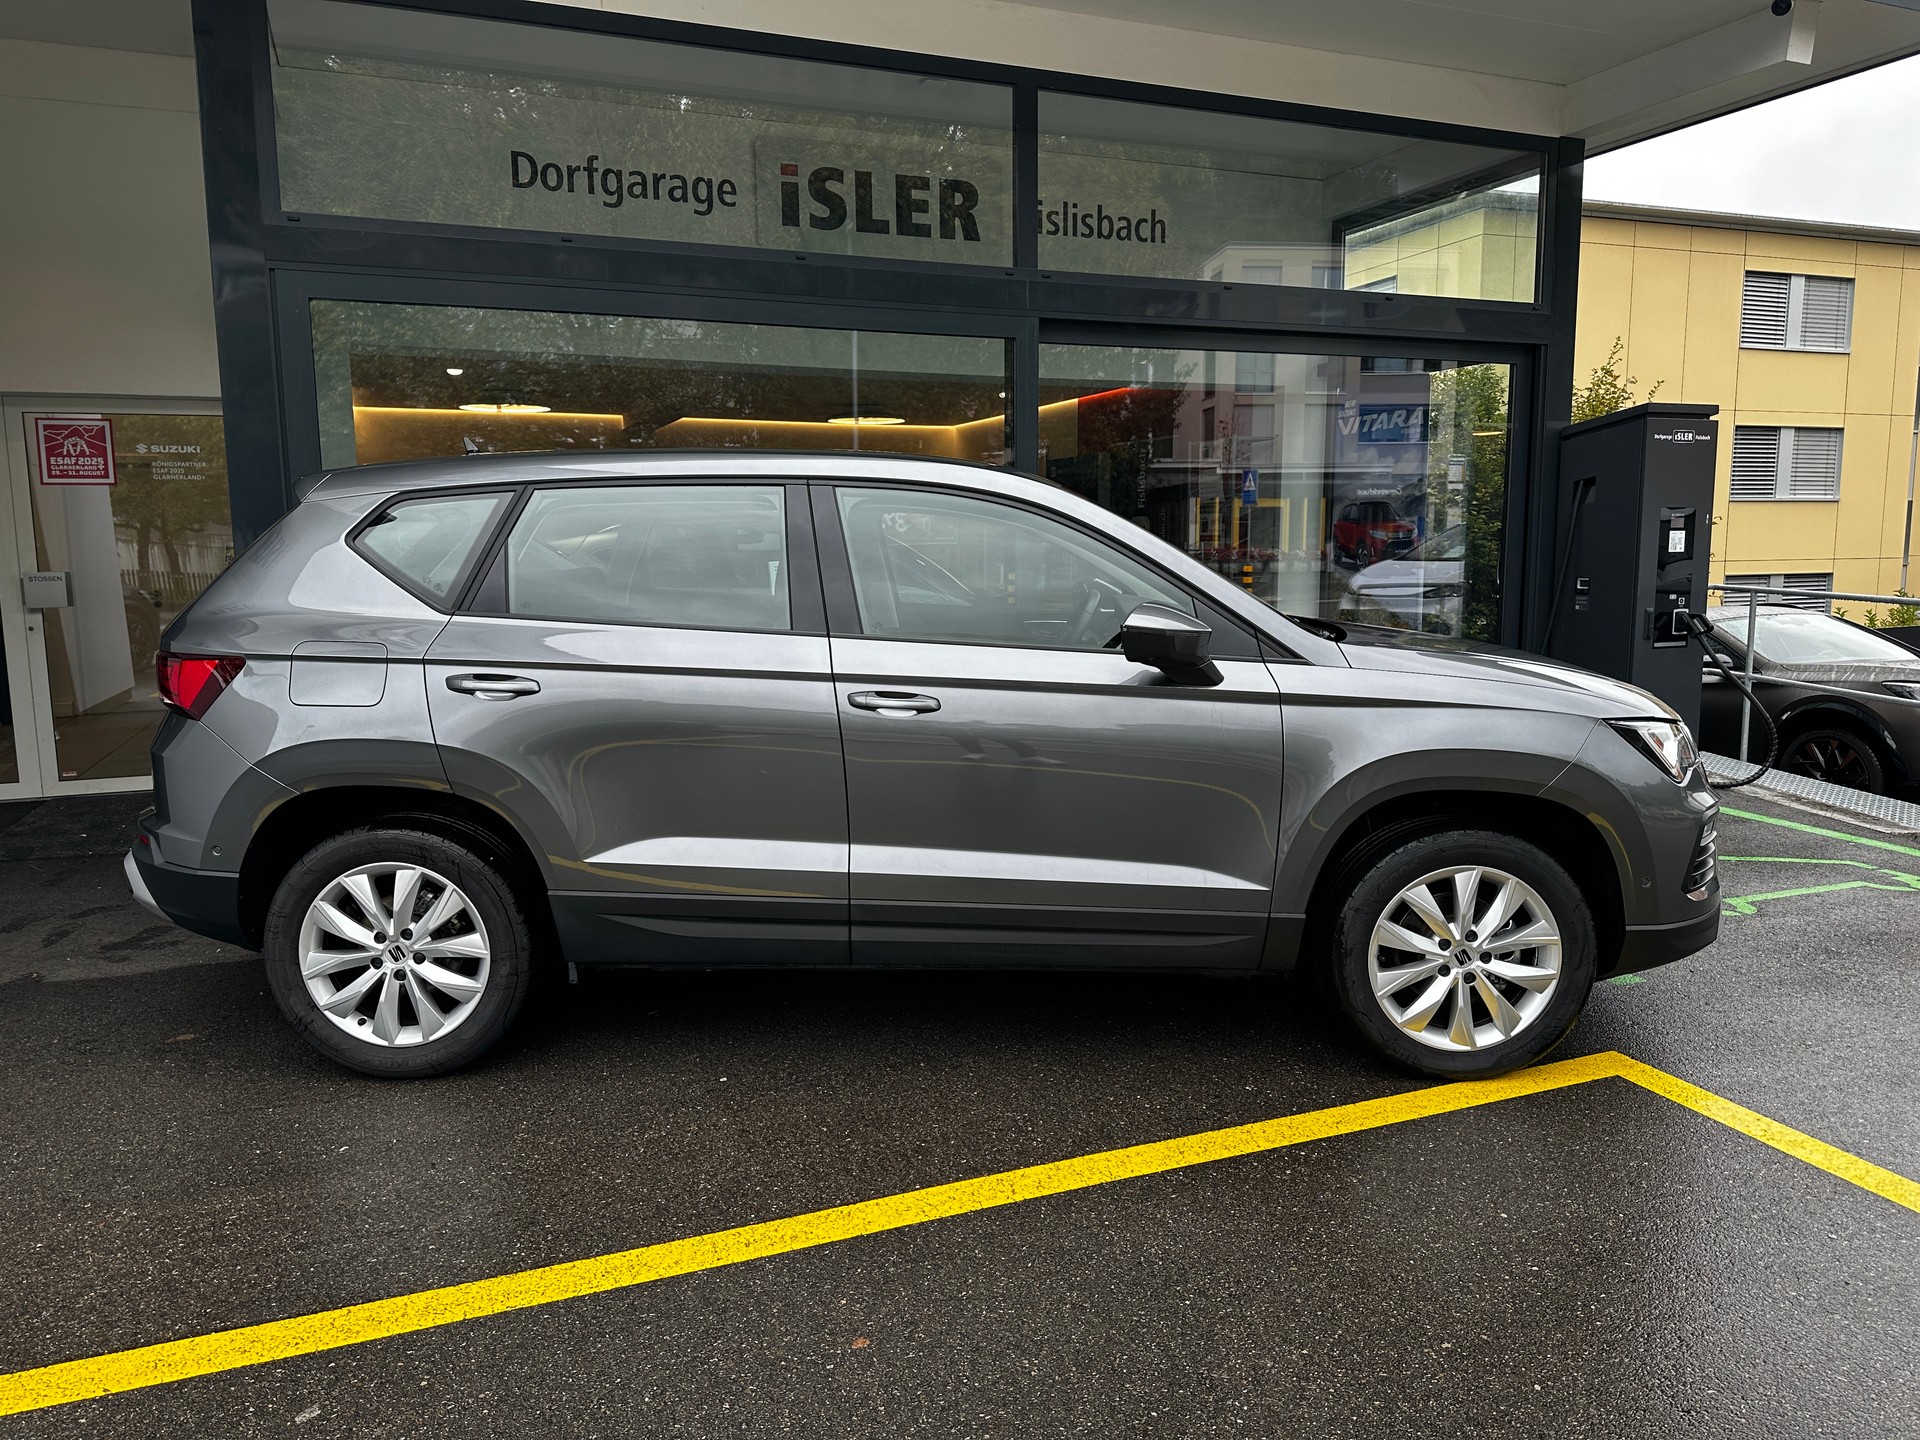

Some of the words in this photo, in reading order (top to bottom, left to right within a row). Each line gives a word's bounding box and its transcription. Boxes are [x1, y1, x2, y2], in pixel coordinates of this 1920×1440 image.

[510, 150, 737, 216] Dorfgarage
[780, 163, 981, 242] iSLER
[1038, 200, 1167, 243] islisbach
[1338, 407, 1424, 435] VITARA
[150, 445, 200, 453] SUZUKI
[50, 457, 77, 465] ESAF
[78, 457, 104, 465] 2025
